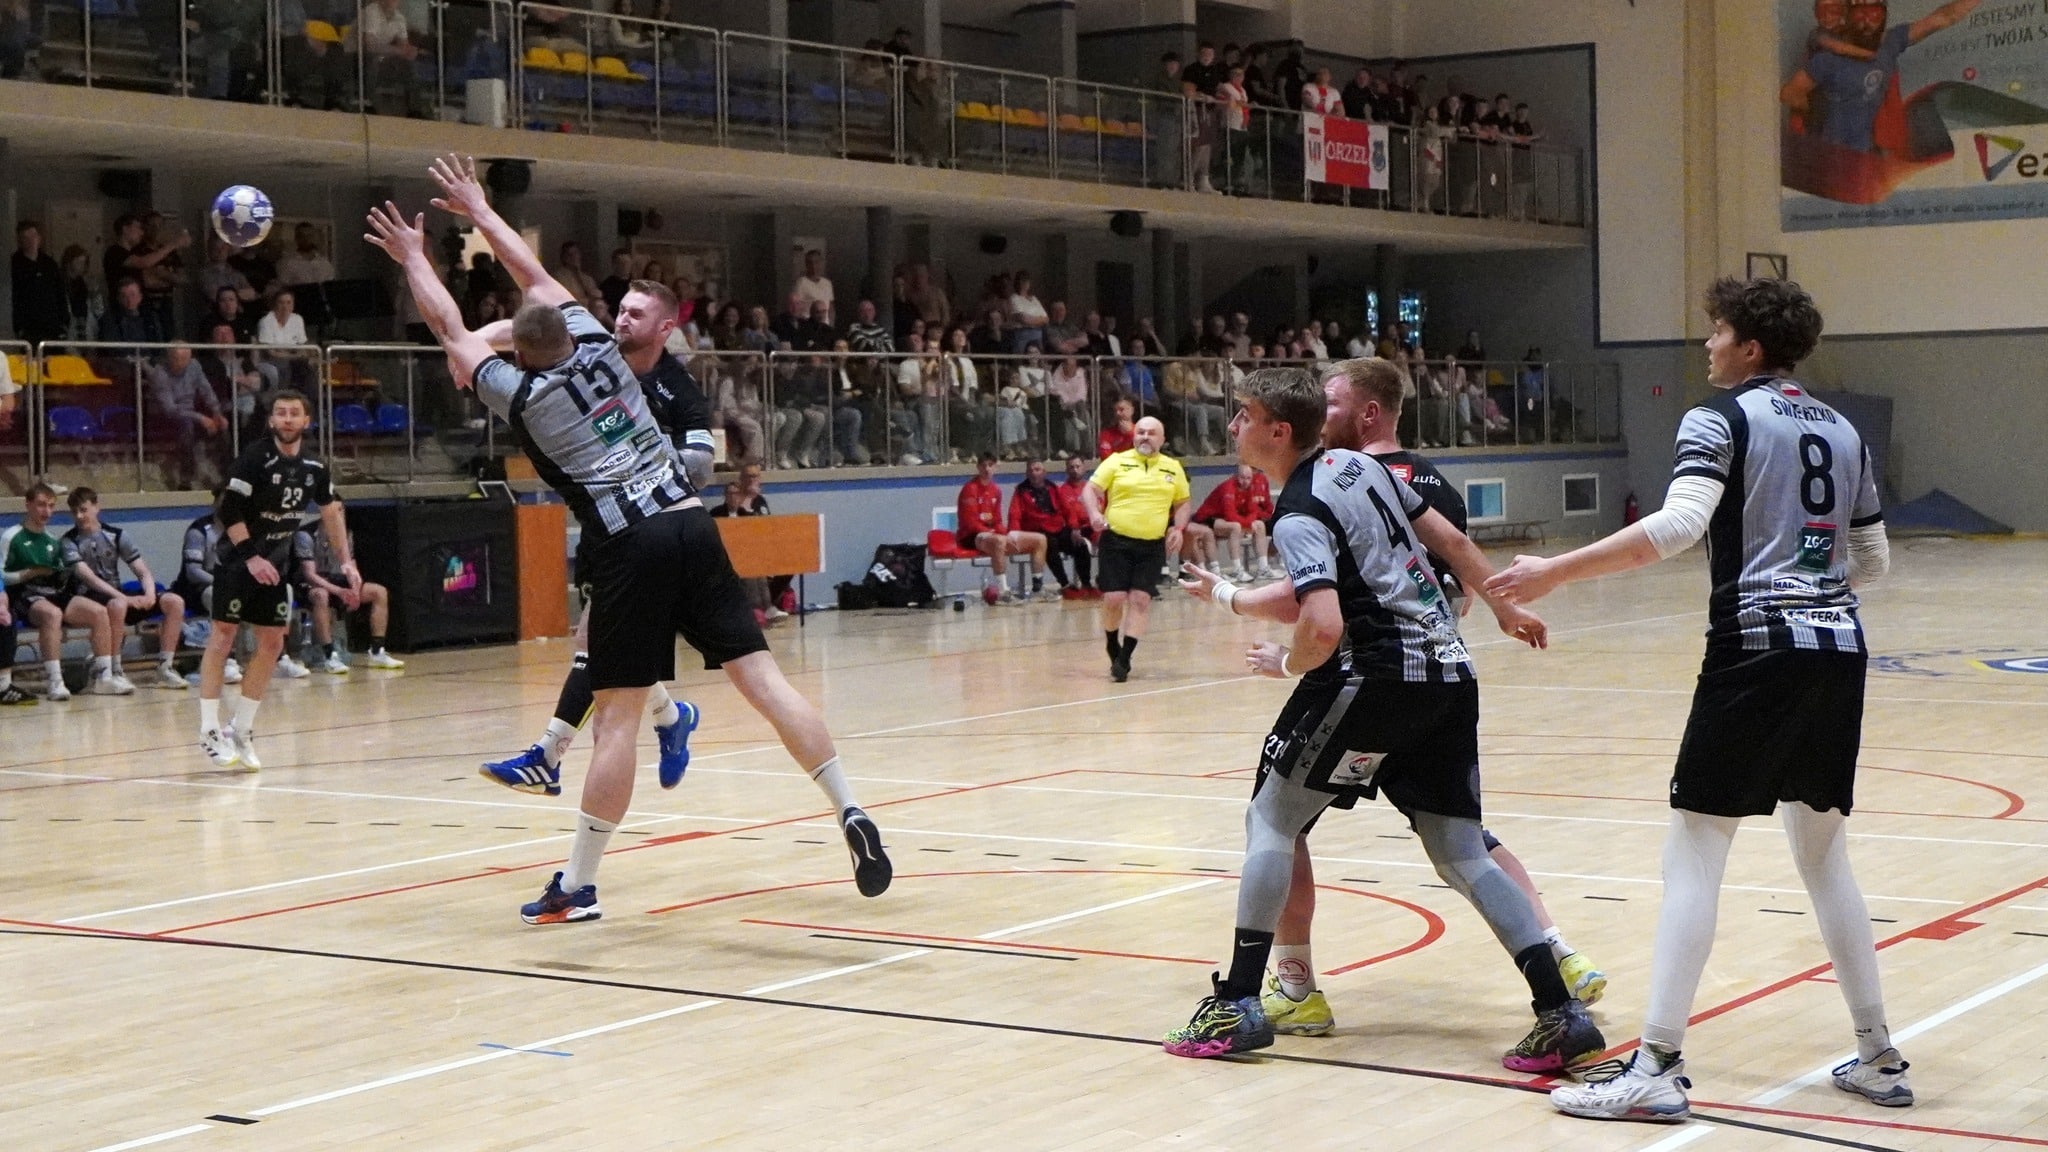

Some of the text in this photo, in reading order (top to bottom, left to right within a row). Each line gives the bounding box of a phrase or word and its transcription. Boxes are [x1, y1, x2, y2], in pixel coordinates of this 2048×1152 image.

[1985, 27, 2034, 49] TWOJA
[598, 410, 626, 431] ZGO
[1413, 475, 1441, 487] auto
[1799, 433, 1836, 516] 8
[281, 486, 303, 509] 23
[1366, 485, 1413, 552] 4
[1804, 535, 1832, 551] ZGO
[1811, 611, 1841, 623] FERA
[1264, 734, 1285, 760] 21
